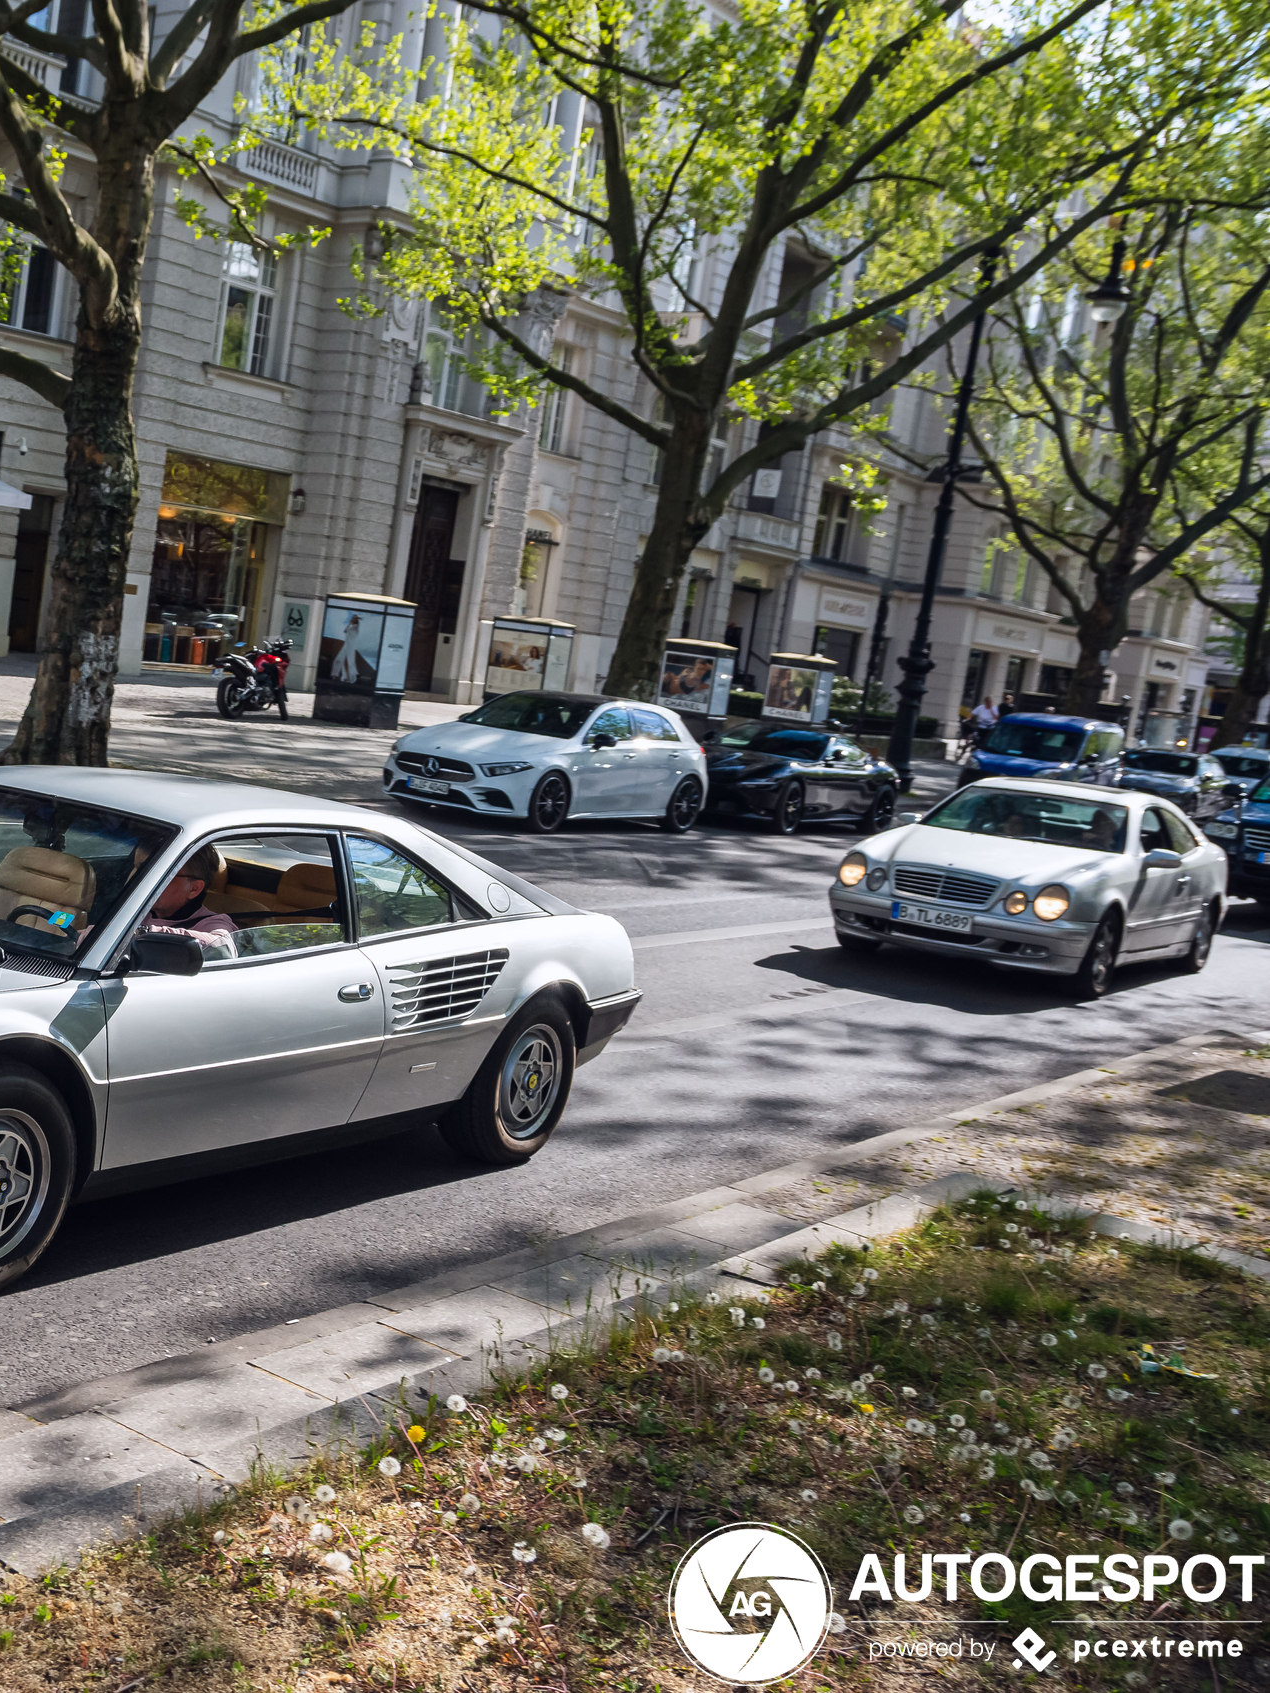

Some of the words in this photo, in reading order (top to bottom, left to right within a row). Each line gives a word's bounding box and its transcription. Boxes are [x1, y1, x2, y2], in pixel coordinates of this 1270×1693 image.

[664, 697, 701, 711] CHANEL
[899, 905, 908, 918] B
[917, 908, 932, 923] TL
[934, 912, 969, 929] 6889
